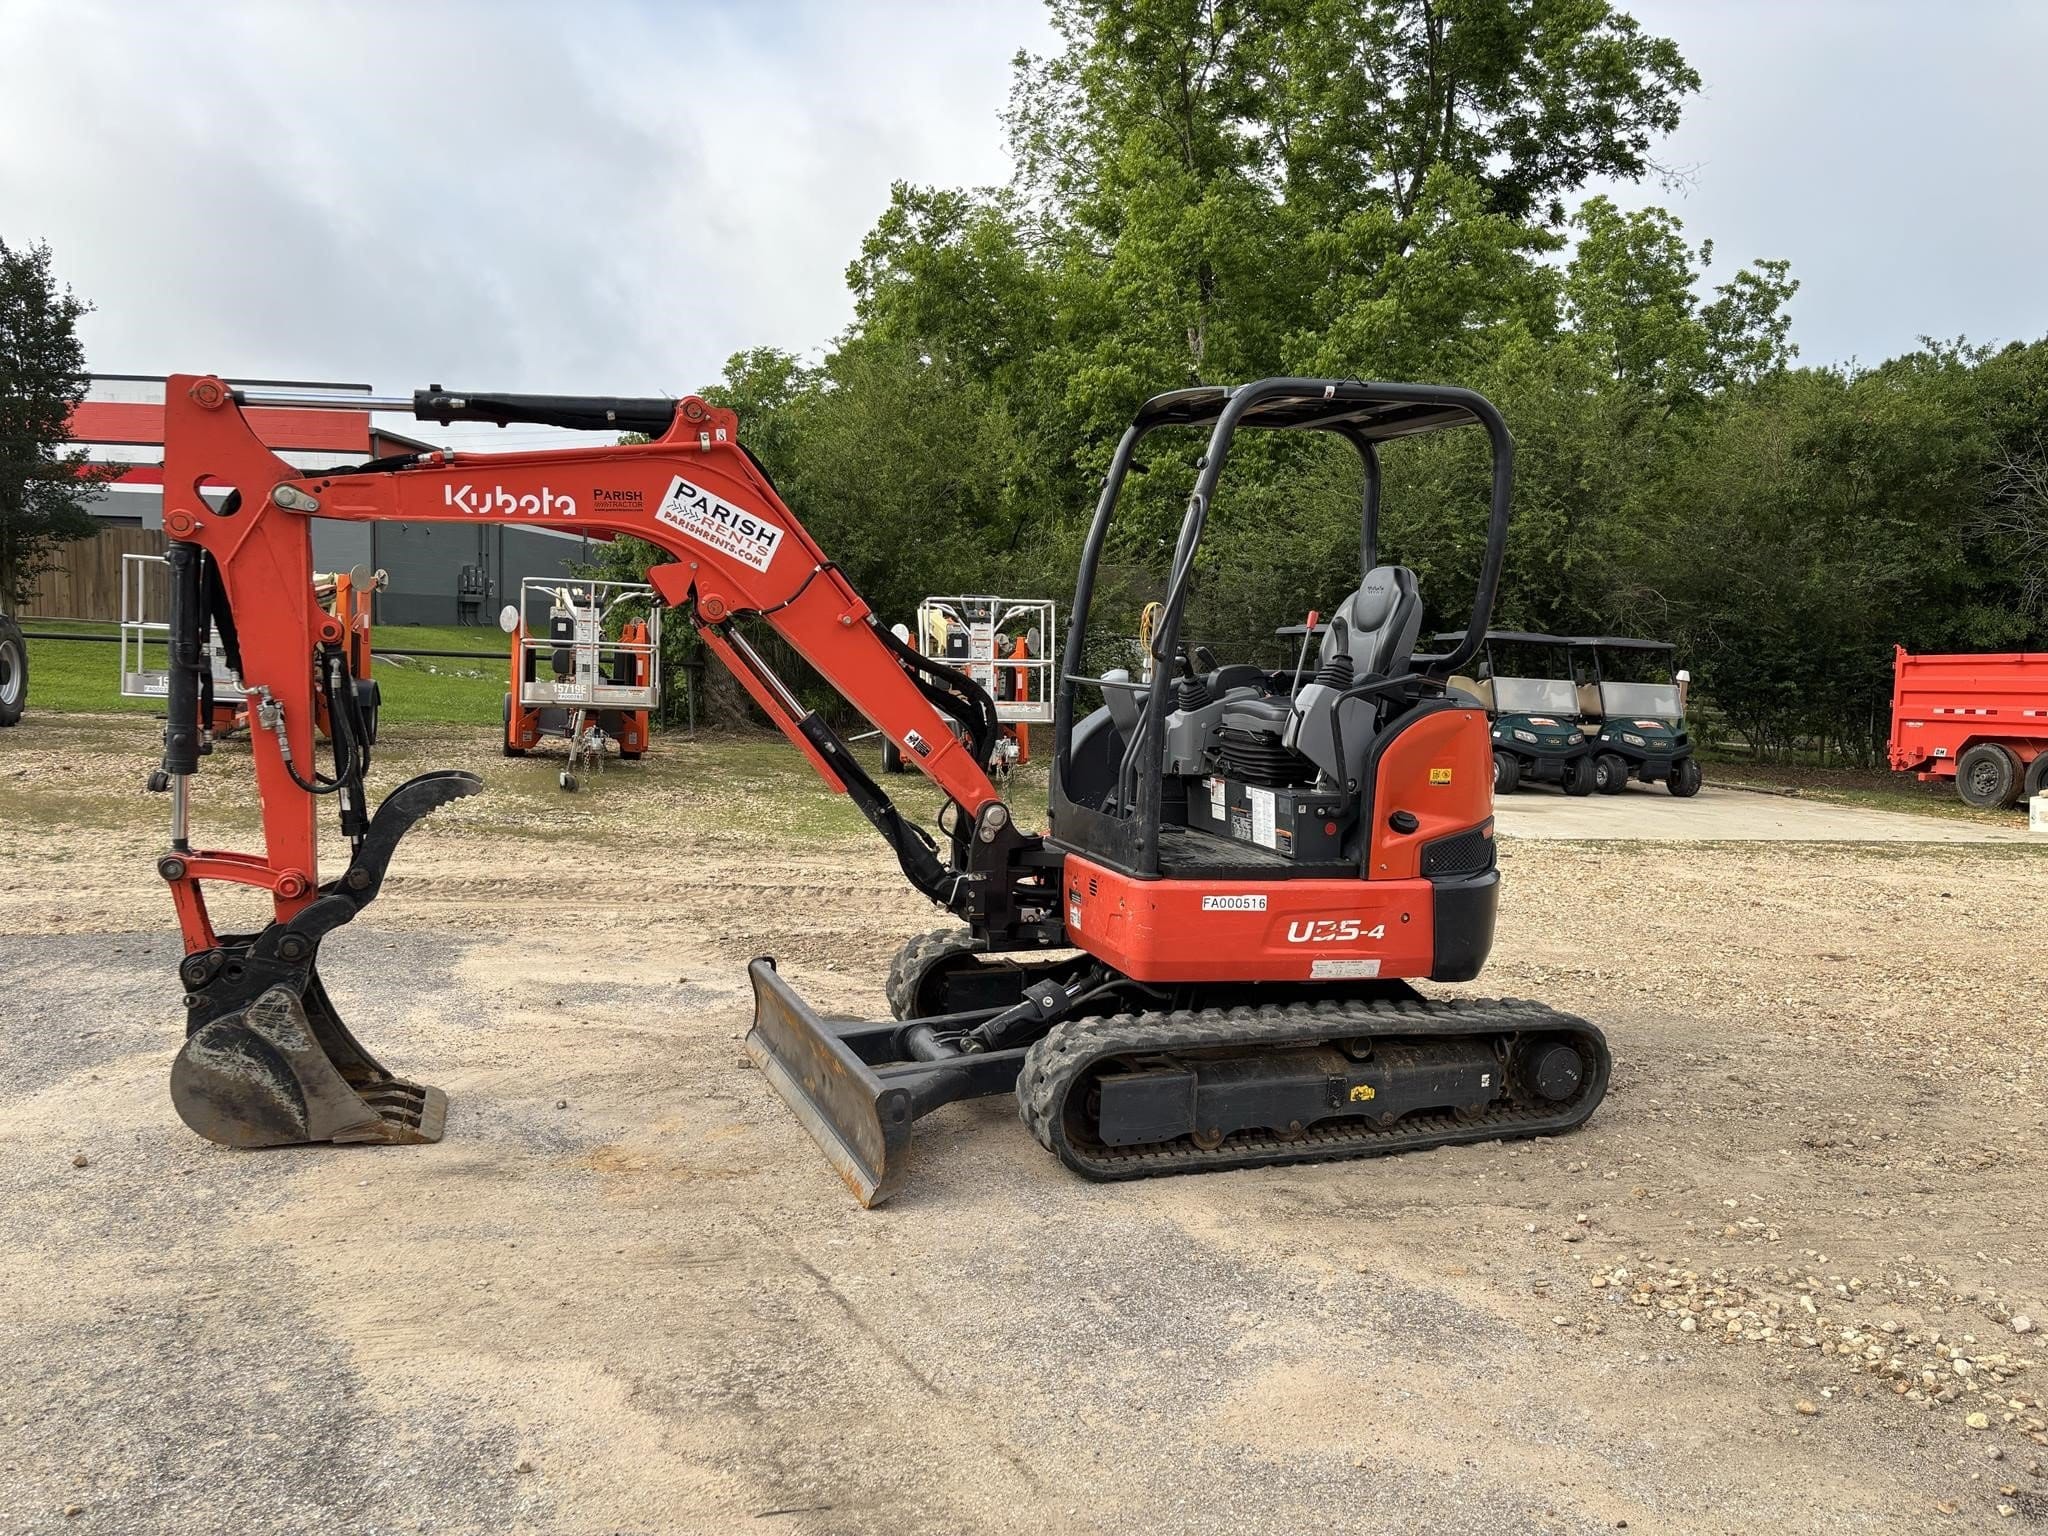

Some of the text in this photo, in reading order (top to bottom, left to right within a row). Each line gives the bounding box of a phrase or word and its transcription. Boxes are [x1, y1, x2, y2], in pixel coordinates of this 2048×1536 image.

[444, 484, 576, 515] Kubota
[593, 488, 643, 501] PARISH
[674, 482, 777, 547] PARISH
[664, 511, 763, 566] PARISHRENTS.COM
[701, 516, 769, 557] RENTS
[553, 683, 587, 694] 15719E
[1203, 897, 1266, 909] FA000516
